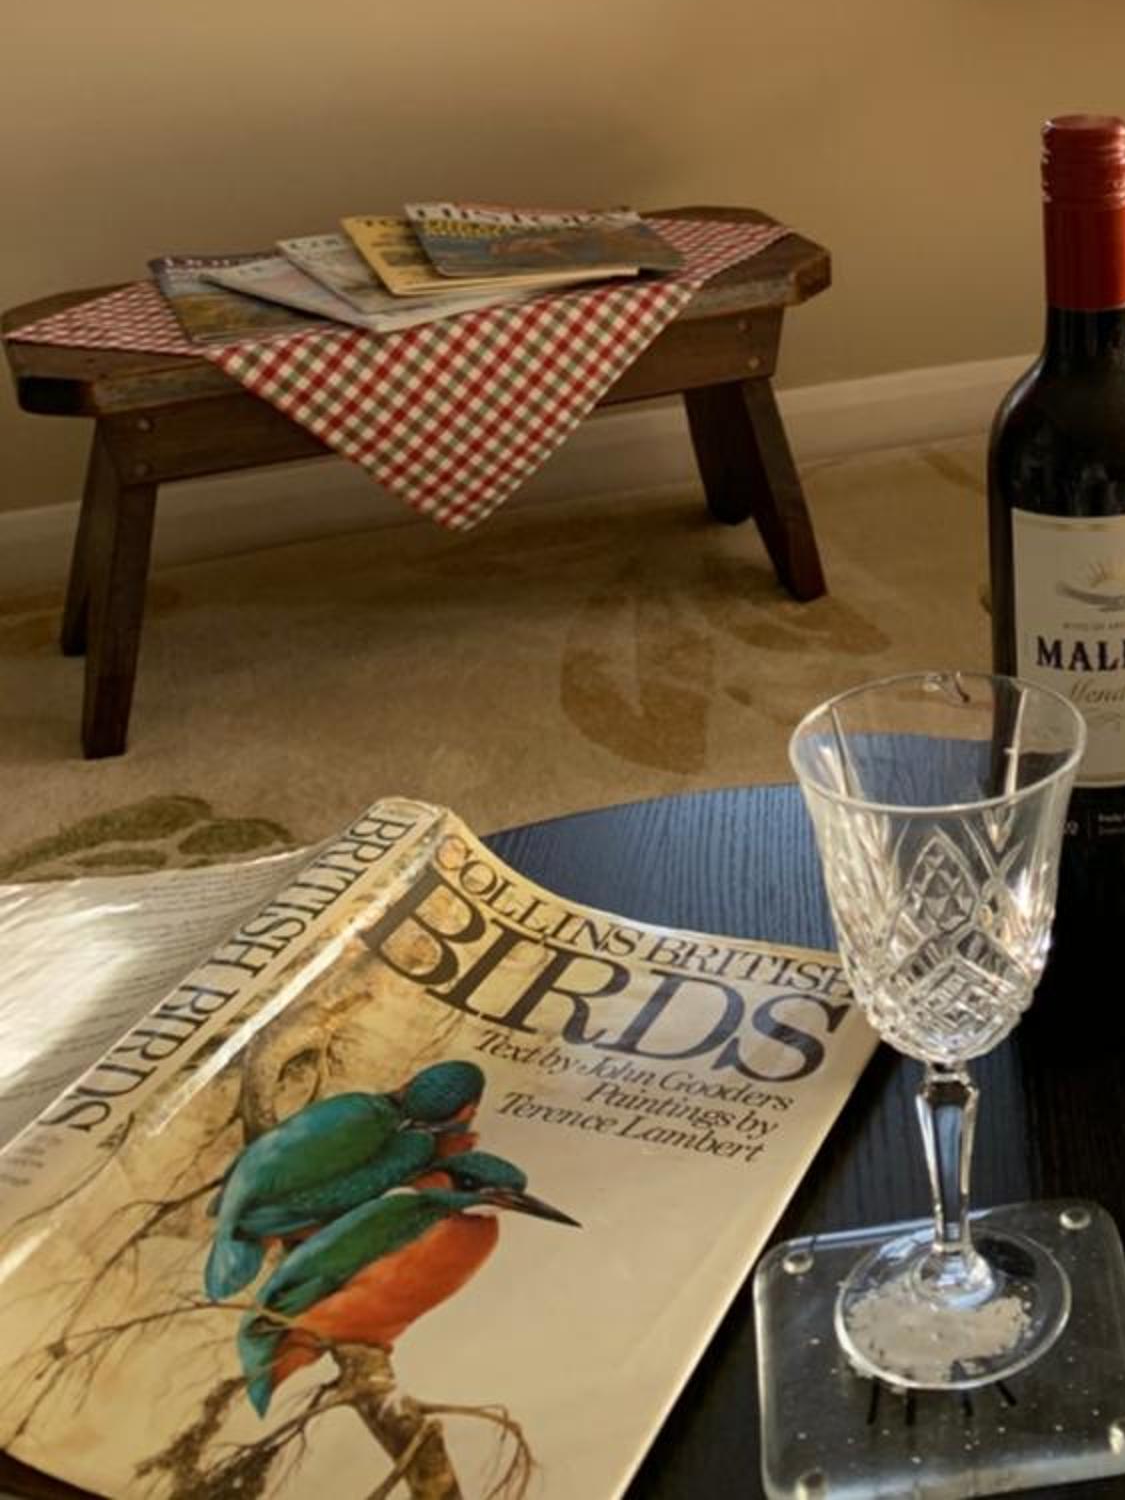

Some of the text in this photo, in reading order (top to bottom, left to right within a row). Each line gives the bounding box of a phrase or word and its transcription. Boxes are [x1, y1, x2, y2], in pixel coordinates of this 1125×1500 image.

[200, 817, 416, 978] BRITISH
[434, 834, 855, 999] COLLINS BRITISH
[361, 861, 850, 1083] BIRDS
[474, 1029, 794, 1111] Text by John Gooders
[497, 1091, 765, 1163] Terence Lambert
[583, 1081, 779, 1140] Paintings by
